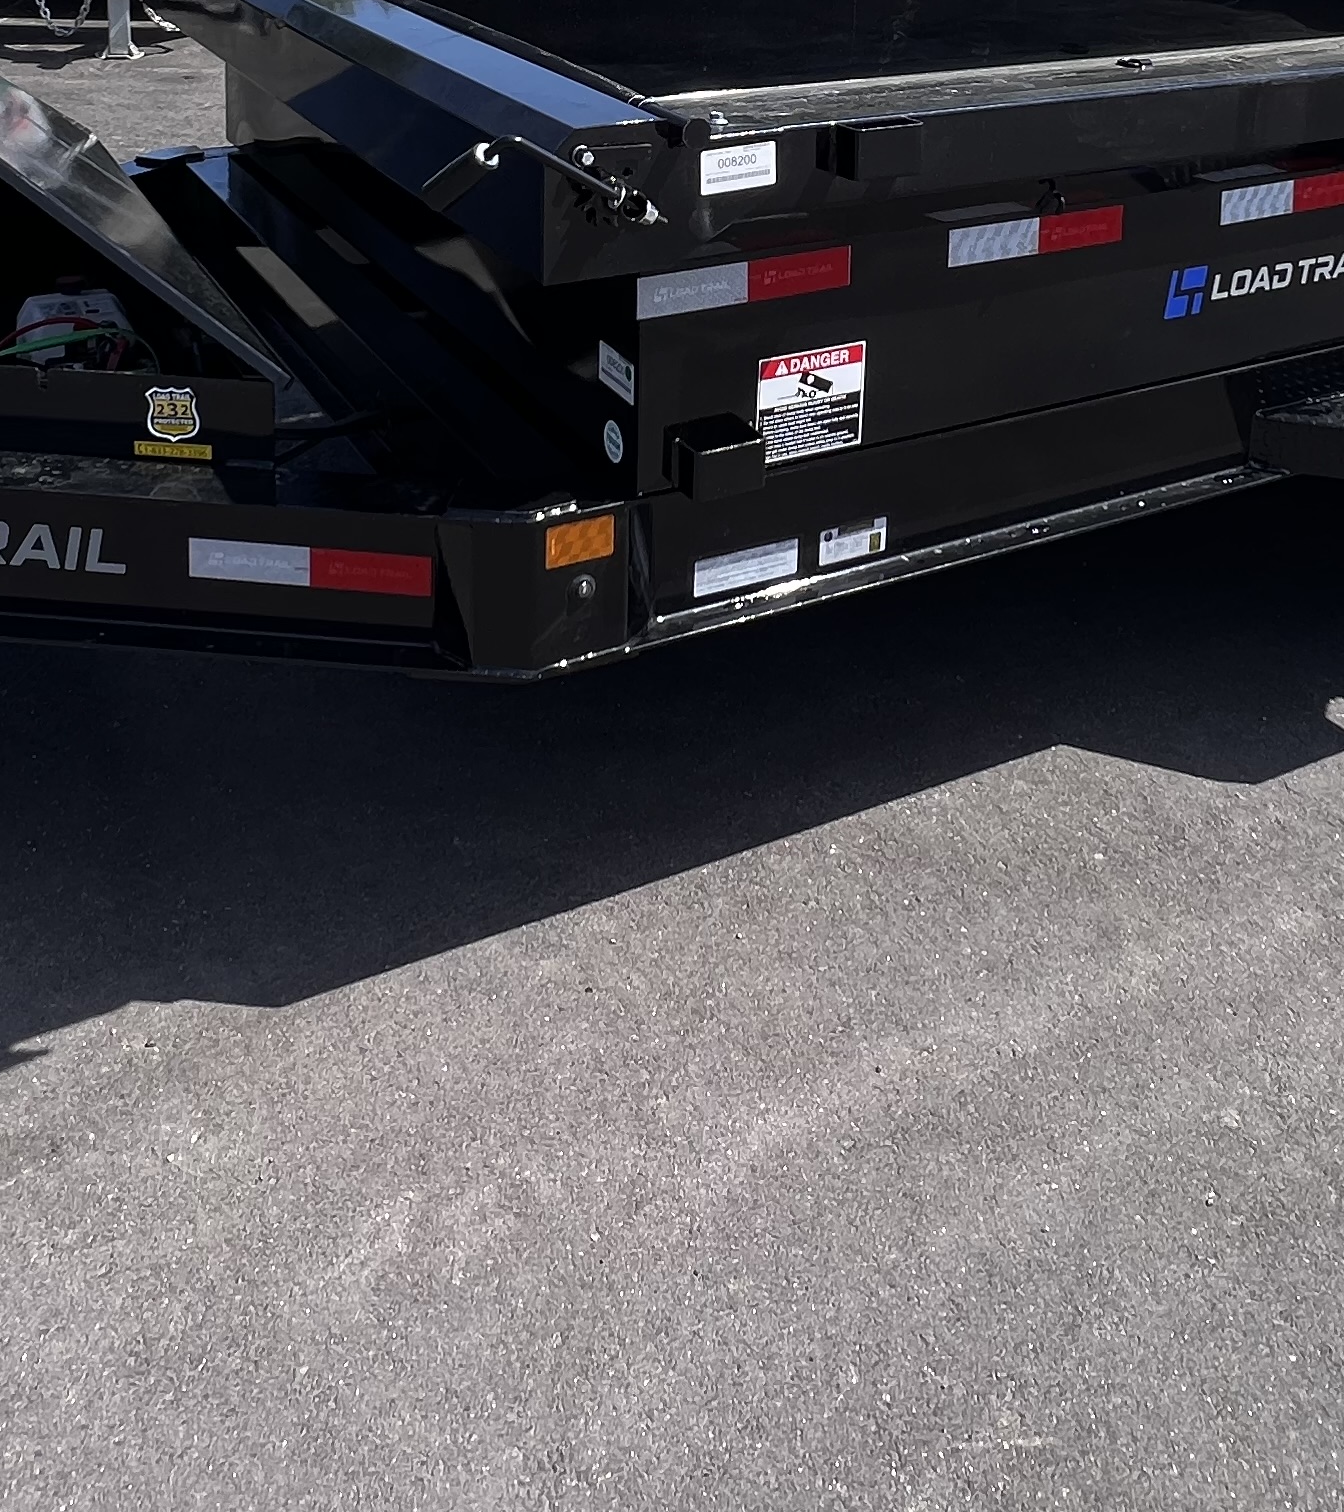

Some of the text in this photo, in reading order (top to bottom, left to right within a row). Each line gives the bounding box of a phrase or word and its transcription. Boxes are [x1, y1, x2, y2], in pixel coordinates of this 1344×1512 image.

[717, 153, 757, 169] 008200
[1210, 261, 1294, 301] LOAD
[790, 349, 850, 372] DANGER
[157, 402, 189, 417] 232
